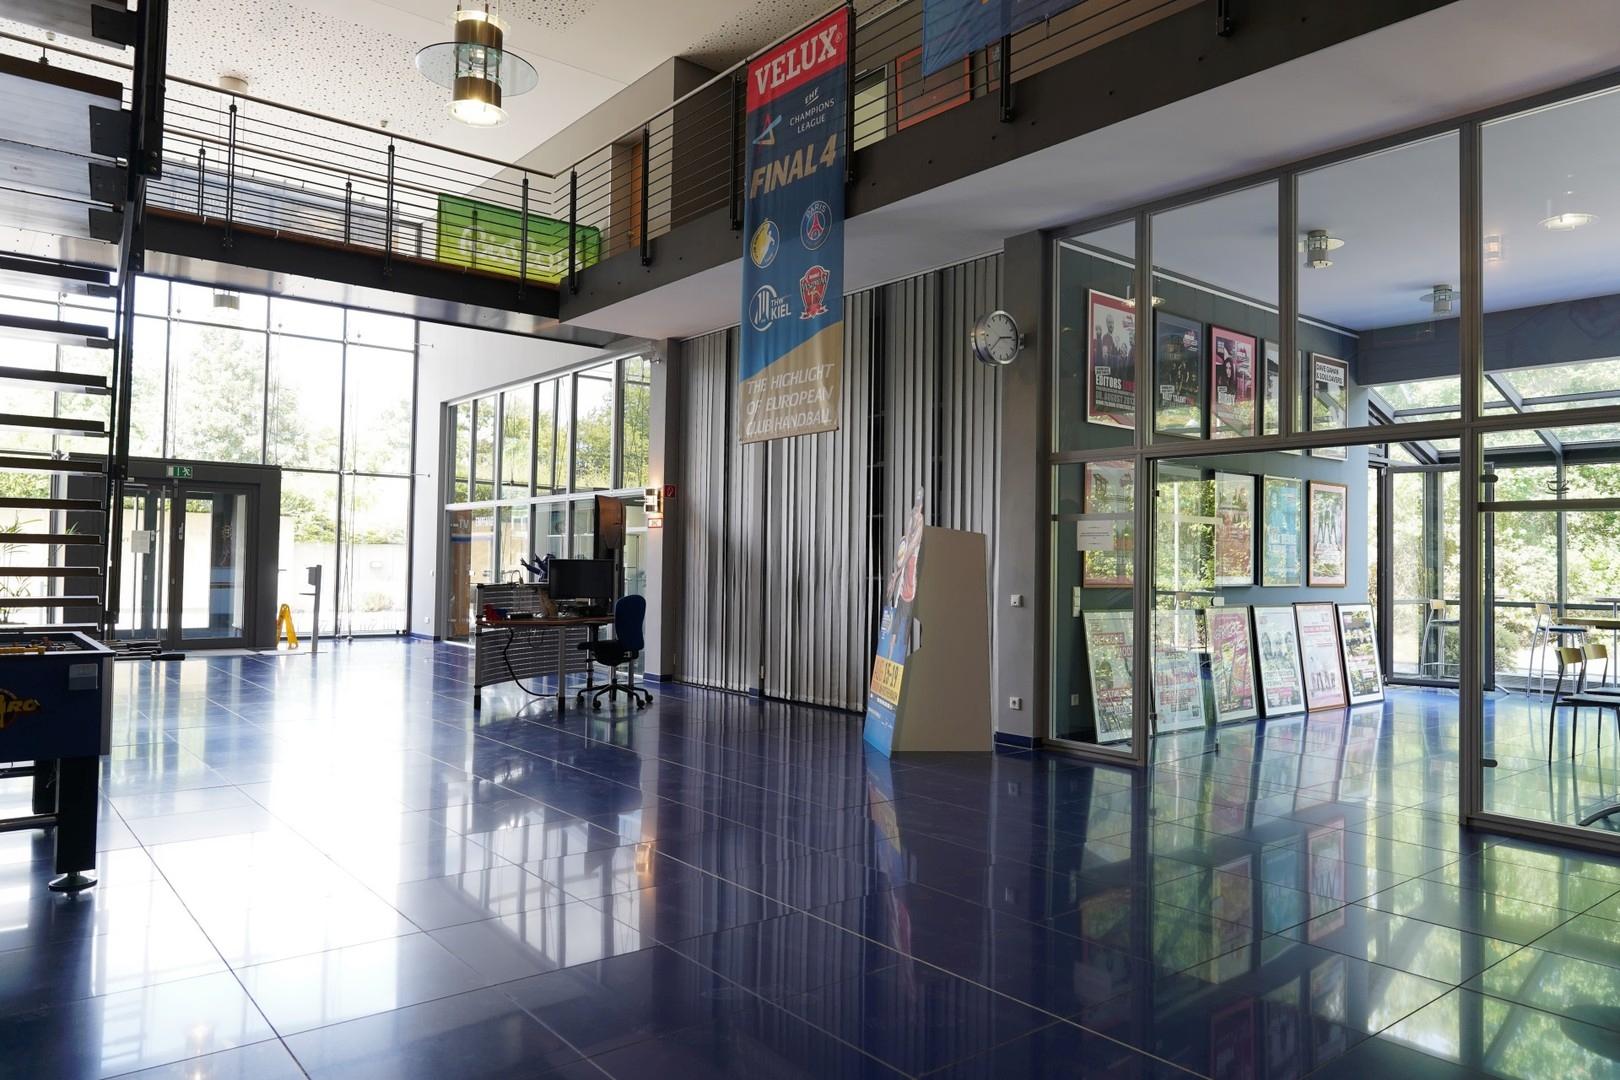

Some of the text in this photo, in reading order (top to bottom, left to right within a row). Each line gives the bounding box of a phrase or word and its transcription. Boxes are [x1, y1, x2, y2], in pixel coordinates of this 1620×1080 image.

[755, 25, 838, 95] VELUX
[804, 87, 820, 105] EHF
[789, 98, 835, 126] CHAMPIONS
[797, 114, 826, 134] LEAGUE
[749, 133, 838, 199] FINAL 4
[805, 203, 827, 219] PARIS
[771, 303, 792, 321] KIEL
[747, 363, 835, 395] THE HIGHLIGHT
[1096, 374, 1122, 390] EDITORS
[746, 385, 834, 416] OF EUROPEAN
[745, 407, 832, 437] CLUB HANDBALL
